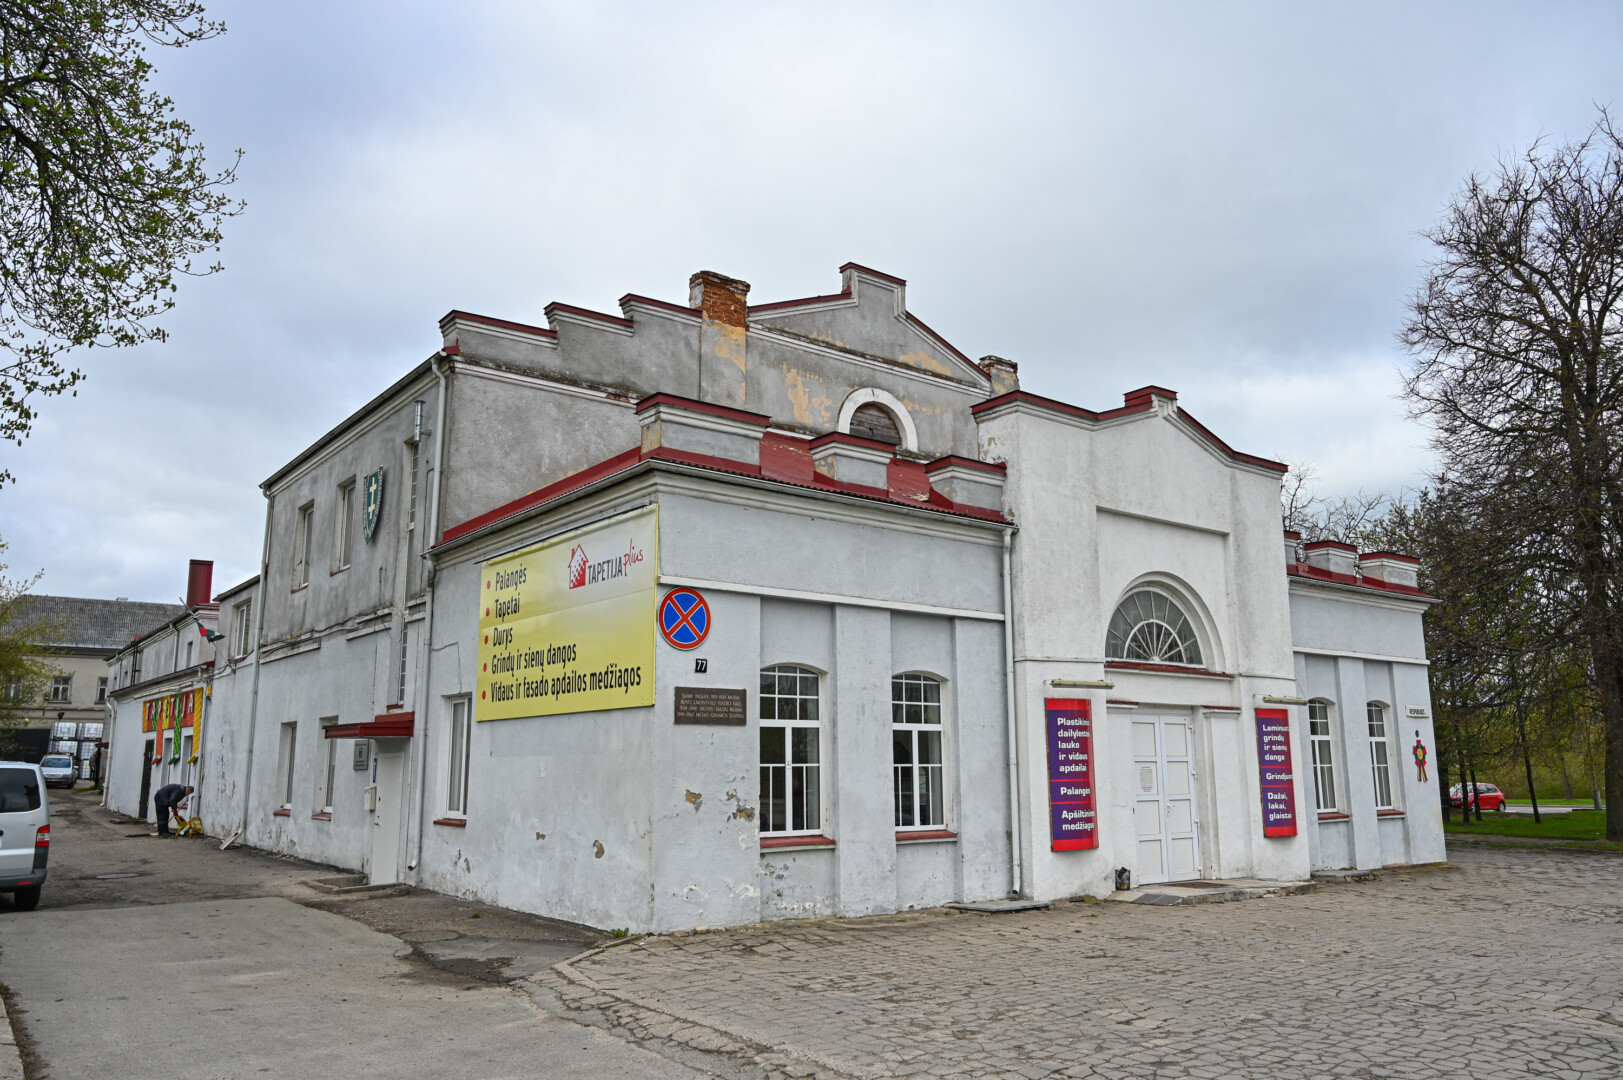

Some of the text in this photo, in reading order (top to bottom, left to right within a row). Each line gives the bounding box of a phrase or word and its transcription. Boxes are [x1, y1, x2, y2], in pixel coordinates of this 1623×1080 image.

[588, 538, 644, 584] TAPETIJA plius
[495, 563, 527, 592] Palangės
[494, 592, 520, 622] Tapetai
[492, 627, 512, 650] Durys
[492, 643, 576, 678] Grindų ir sienų dangos
[697, 660, 706, 671] 77
[491, 662, 641, 702] Vidaus ir fasado apdailos medžiagos
[1058, 740, 1080, 749] lauko
[1058, 752, 1088, 760] ir vidaus
[1265, 754, 1284, 762] danga
[1060, 764, 1087, 774] apdailai
[1268, 802, 1287, 810] lakai,
[1269, 812, 1292, 821] glaistai
